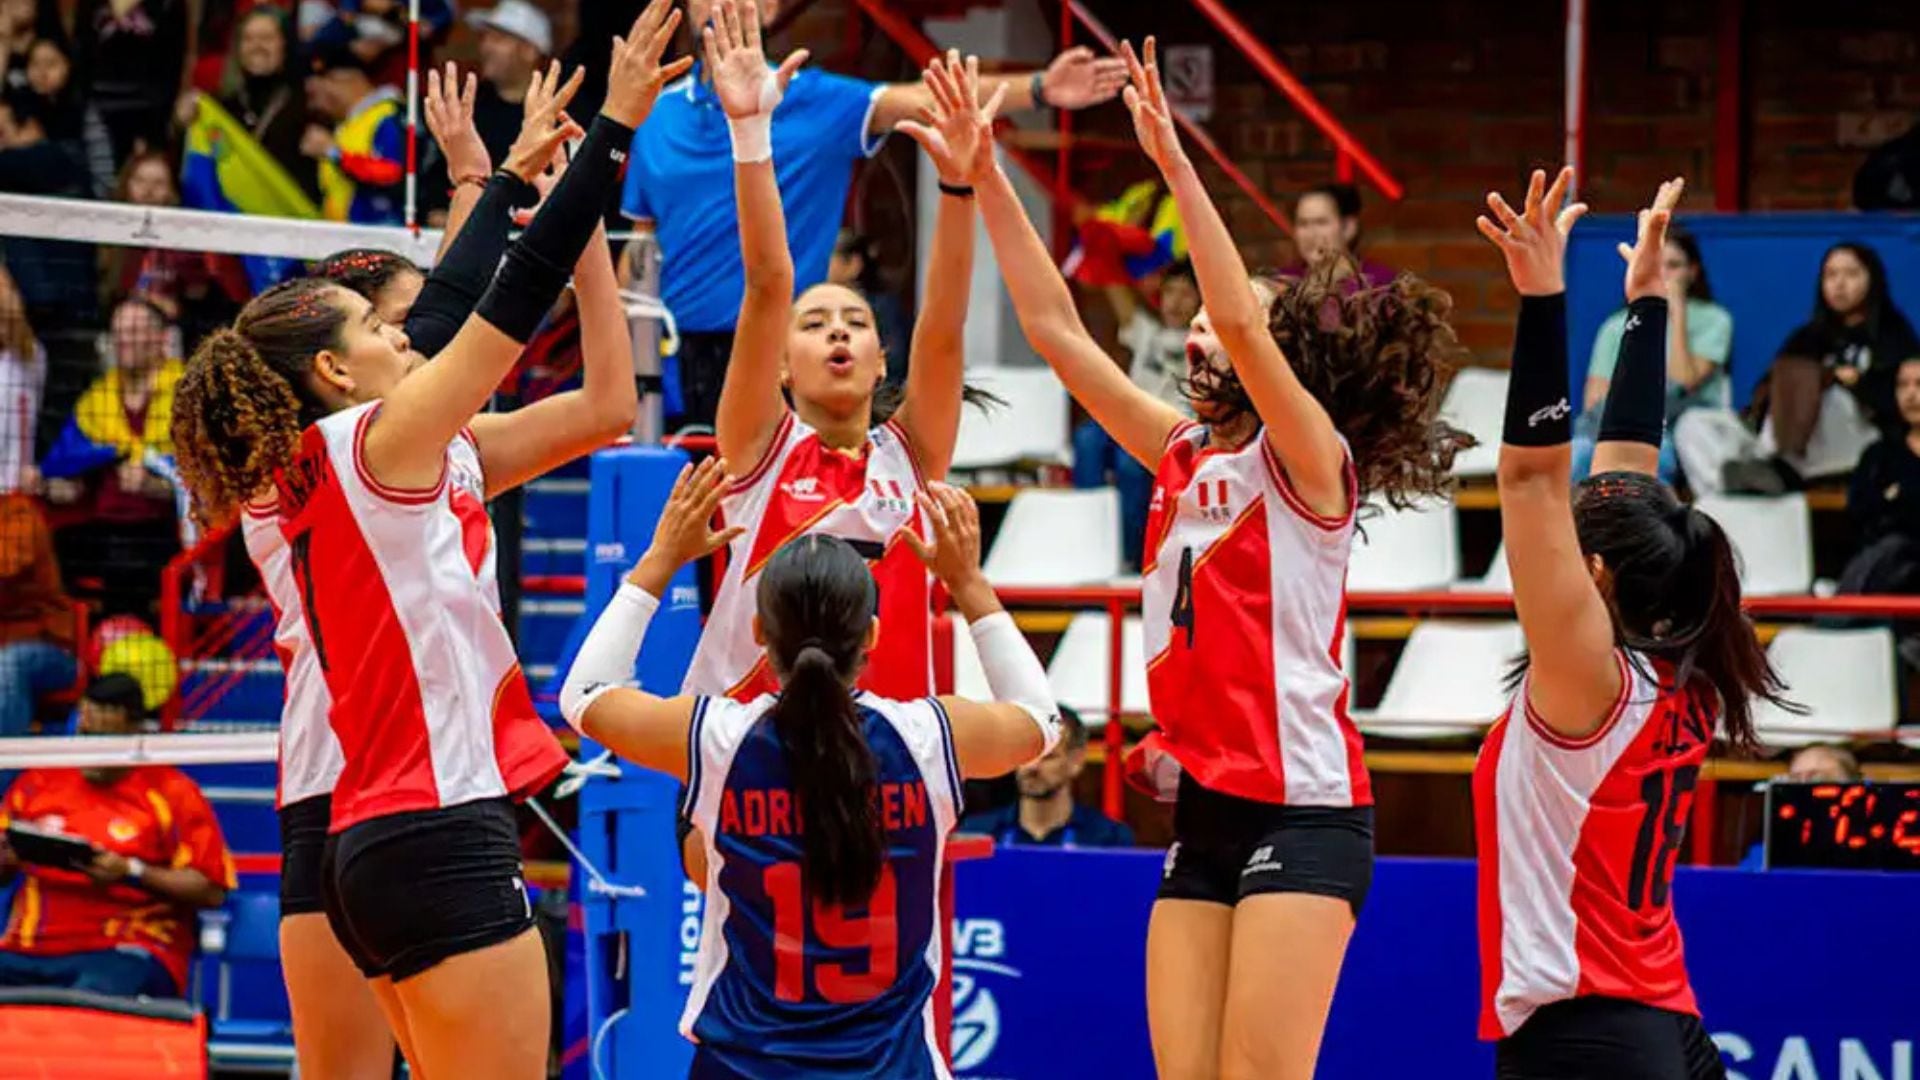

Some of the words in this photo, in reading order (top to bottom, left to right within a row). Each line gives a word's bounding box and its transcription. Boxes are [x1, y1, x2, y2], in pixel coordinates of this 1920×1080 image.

[876, 498, 909, 513] PER
[1200, 506, 1231, 521] PER
[1170, 546, 1195, 650] 4
[762, 860, 898, 1005] 19
